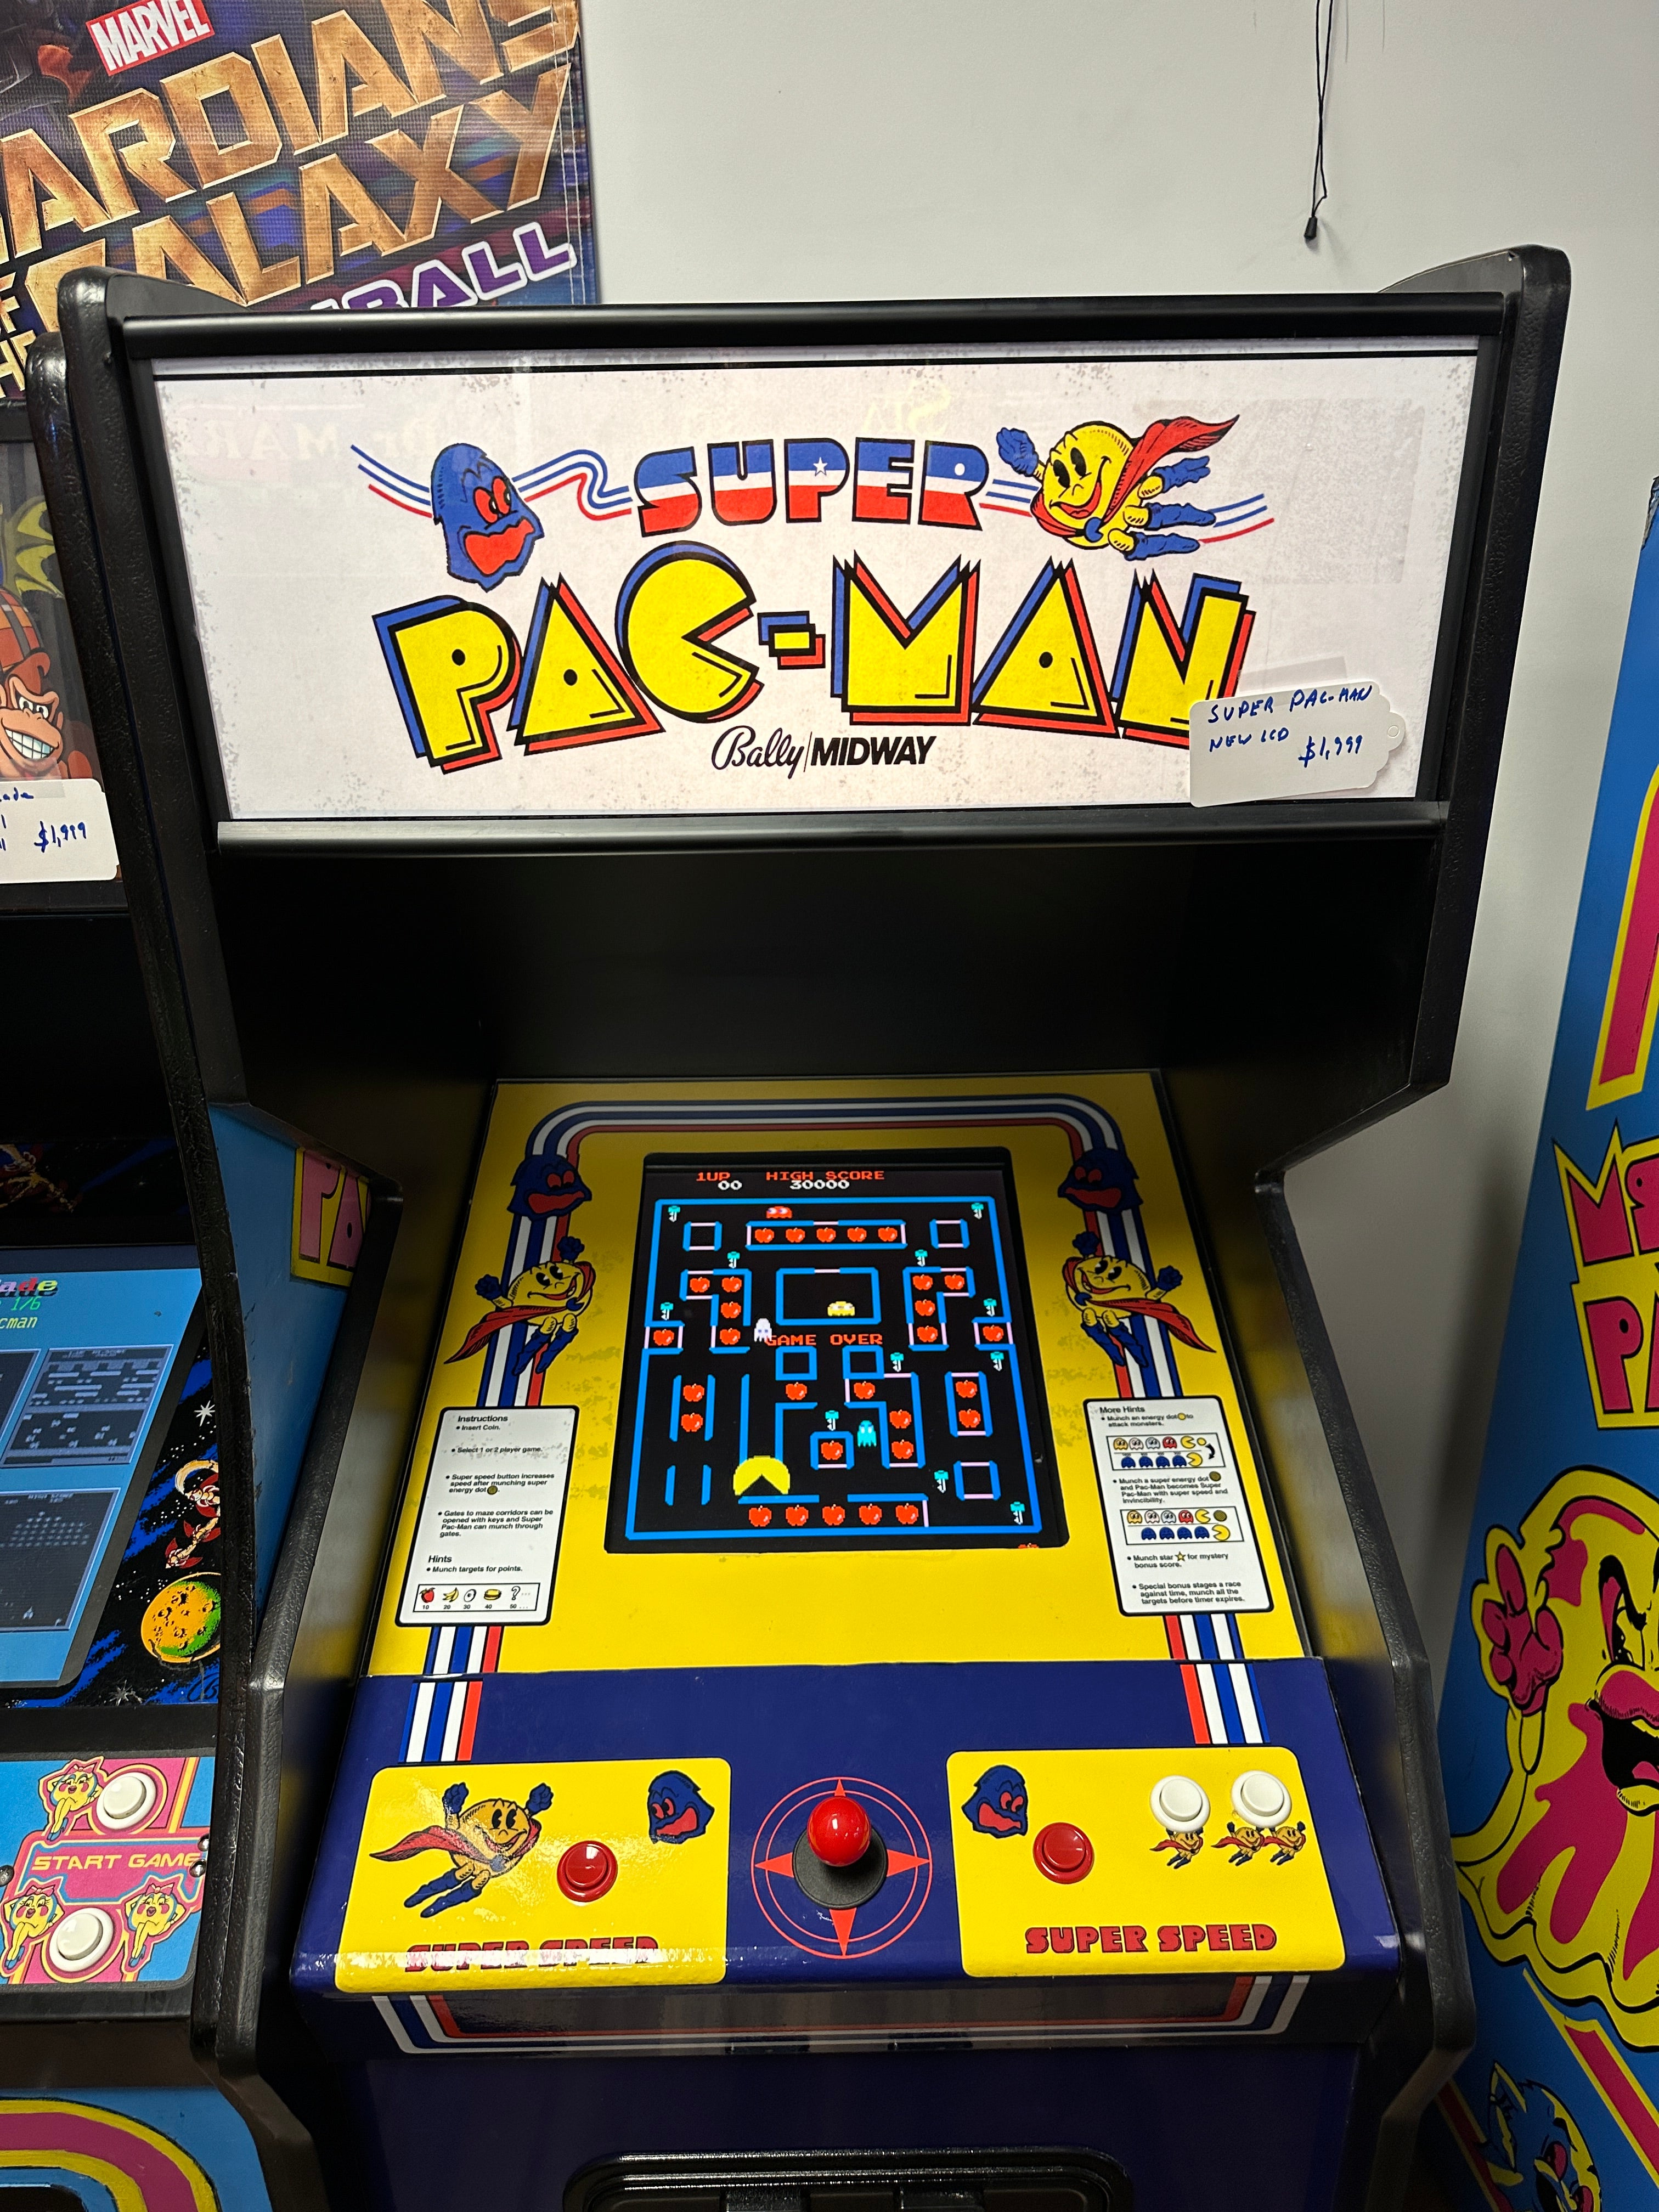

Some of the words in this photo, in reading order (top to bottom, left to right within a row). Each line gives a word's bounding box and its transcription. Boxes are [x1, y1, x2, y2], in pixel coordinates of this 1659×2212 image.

[92, 0, 211, 71] MARVEL
[0, 0, 580, 262] ARDIANS
[311, 222, 577, 307] BALL
[634, 436, 990, 537] SUPER
[372, 540, 1256, 775] PAC-MAN
[1208, 696, 1273, 723] SUPER
[1289, 685, 1372, 712] PAC-MAN
[811, 736, 937, 766] MIDWAY
[1209, 734, 1251, 752] NEW
[1298, 735, 1363, 768] $1,999
[34, 821, 86, 853] $1,999
[696, 1172, 730, 1181] 1UP
[766, 1172, 813, 1181] HIGH
[826, 1171, 884, 1180] SCORE
[718, 1180, 742, 1190] 00
[790, 1180, 849, 1189] 30000
[765, 1334, 816, 1346] GAME
[830, 1334, 882, 1345] OVER
[31, 1854, 122, 1870] START
[128, 1853, 201, 1868] GAME
[1025, 1925, 1148, 1954] SUPER
[1157, 1924, 1277, 1952] SPEED
[405, 1940, 528, 1972] SUPER
